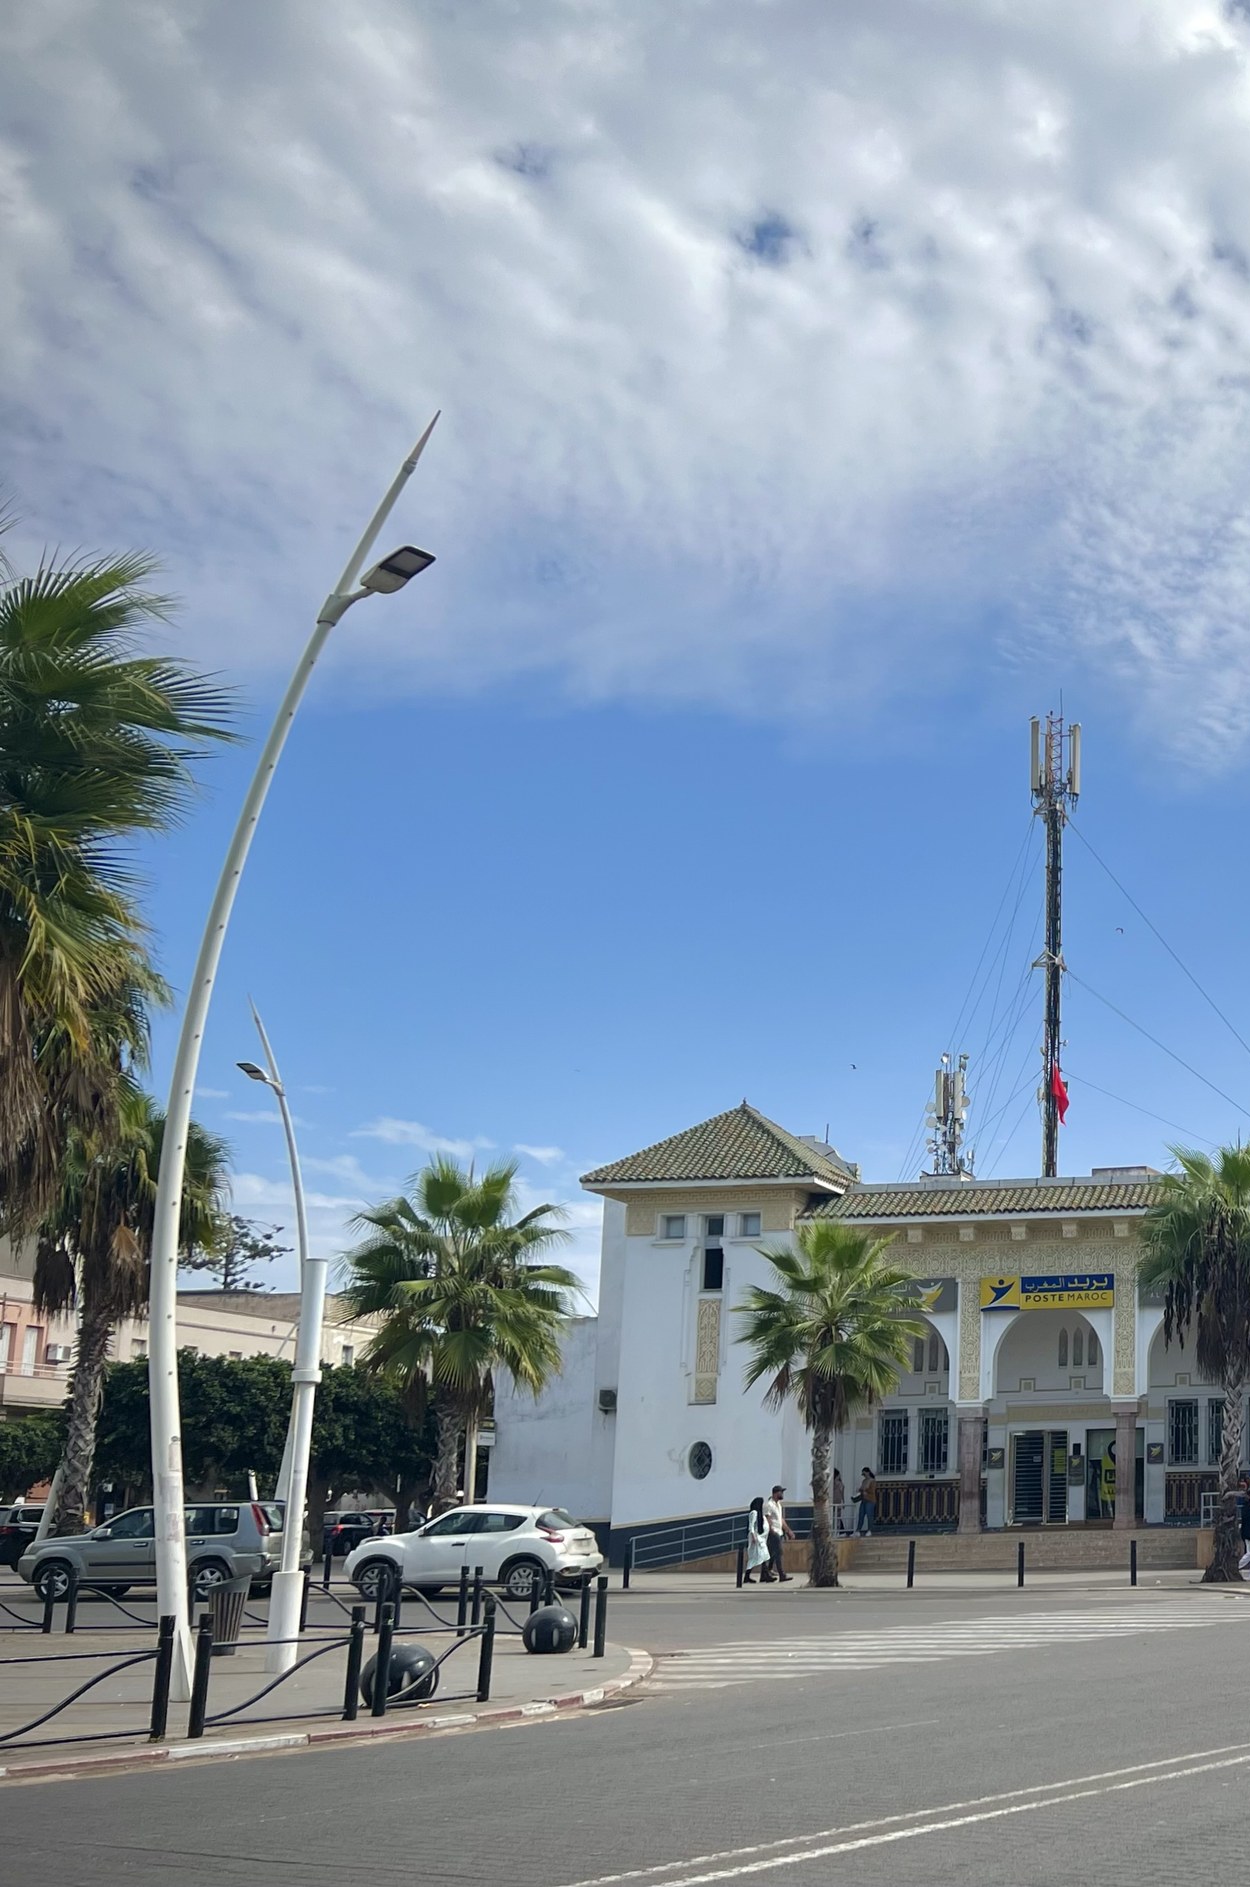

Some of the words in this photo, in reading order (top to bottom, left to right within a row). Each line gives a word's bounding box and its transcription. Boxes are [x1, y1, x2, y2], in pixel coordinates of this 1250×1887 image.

[1025, 1277, 1065, 1293] المغرب
[1067, 1276, 1109, 1290] بريد
[1025, 1293, 1065, 1303] POSTE
[1067, 1291, 1108, 1301] MAROC
